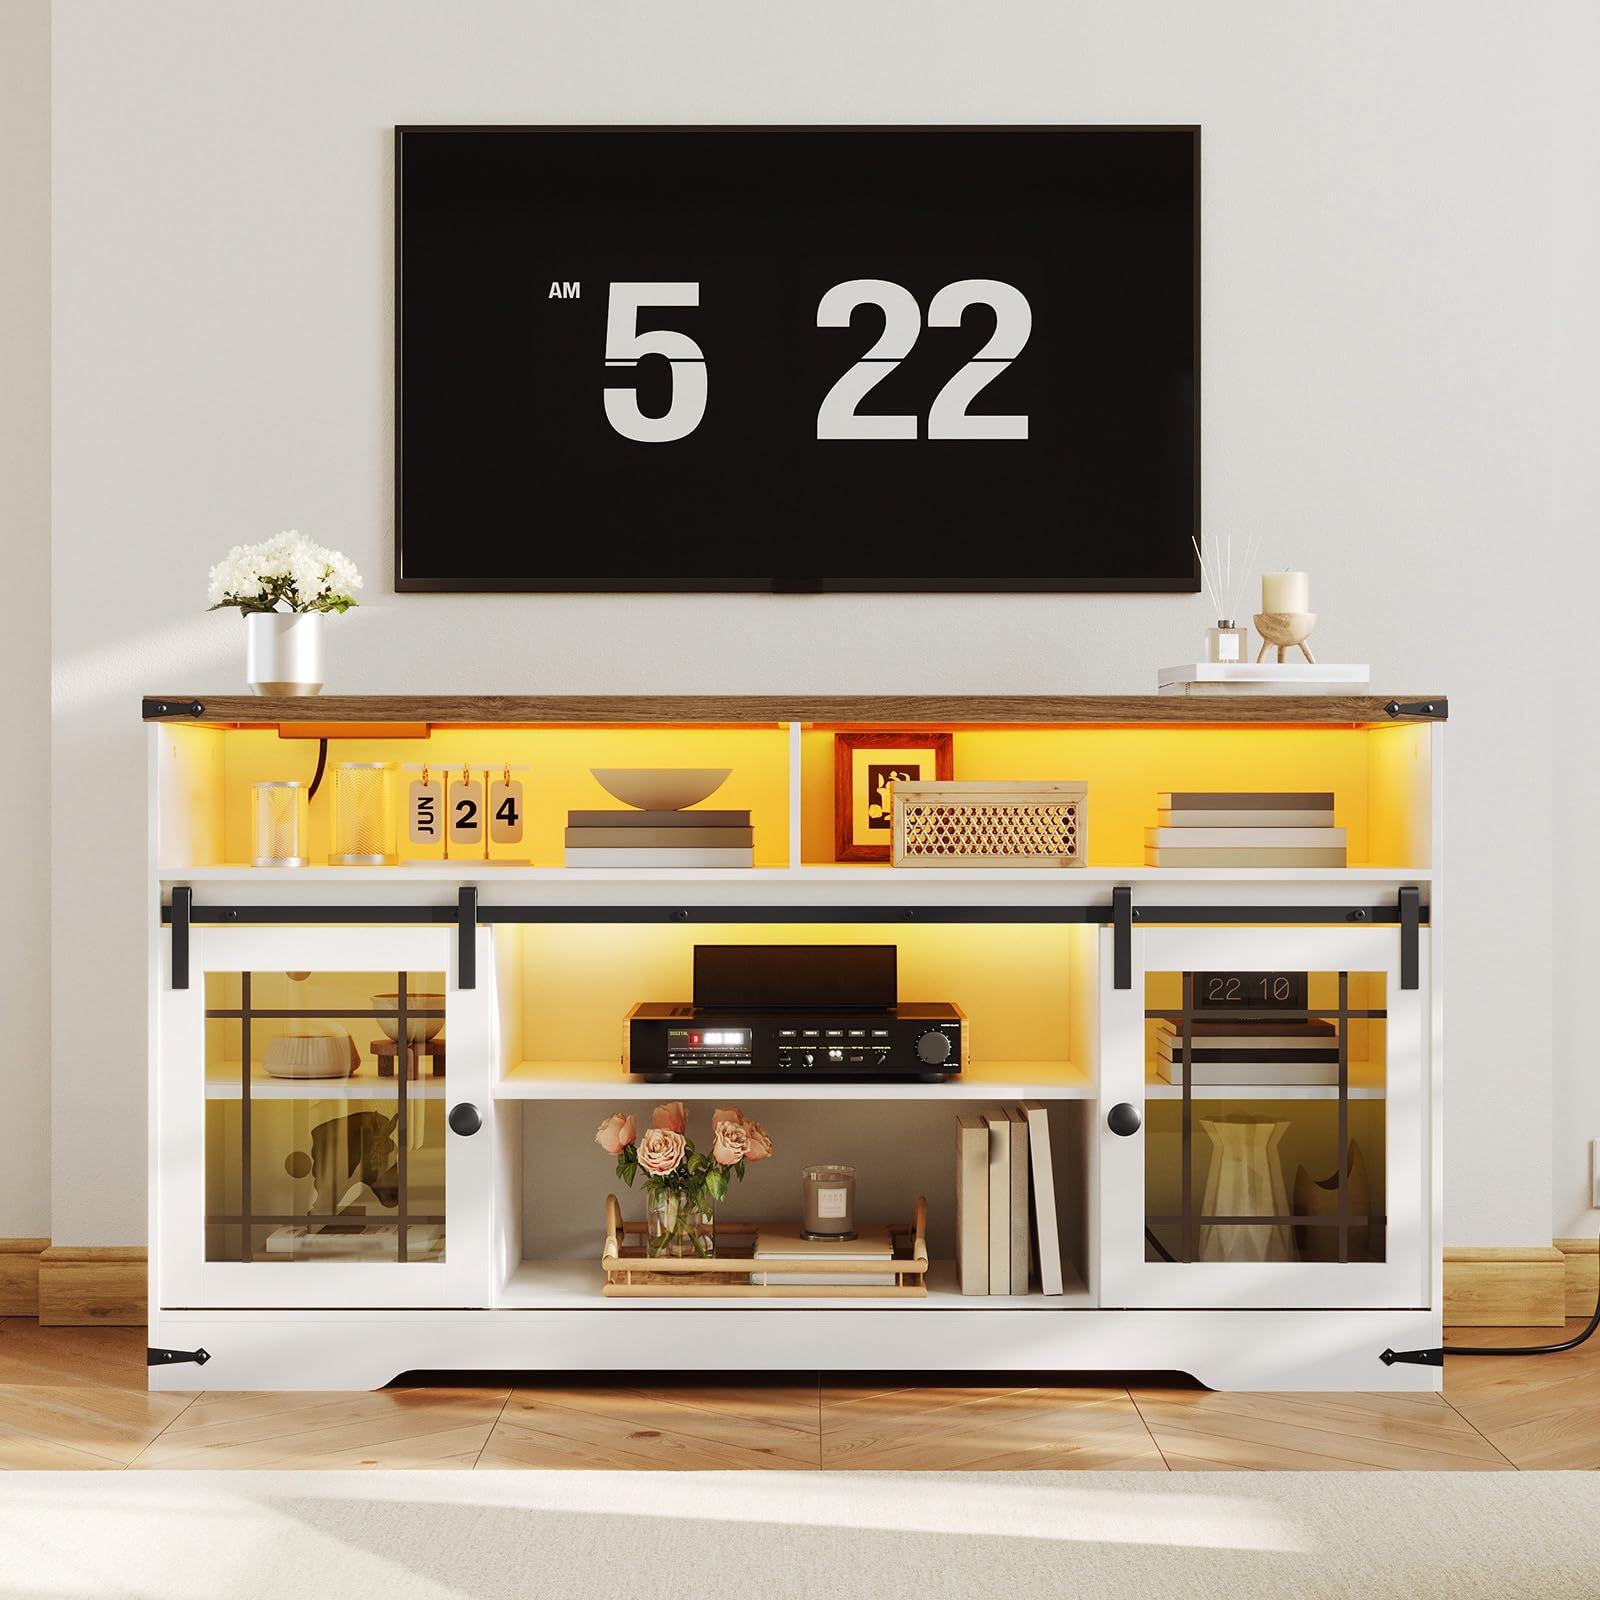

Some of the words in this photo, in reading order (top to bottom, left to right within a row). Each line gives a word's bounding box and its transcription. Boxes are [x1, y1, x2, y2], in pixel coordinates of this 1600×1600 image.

[548, 281, 581, 299] AM
[603, 282, 708, 443] 5
[816, 278, 1032, 440] 22
[417, 797, 434, 835] JUN
[455, 800, 478, 829] 2
[495, 797, 519, 826] 4
[1208, 977, 1241, 1000] 22
[1259, 977, 1290, 1000] 10
